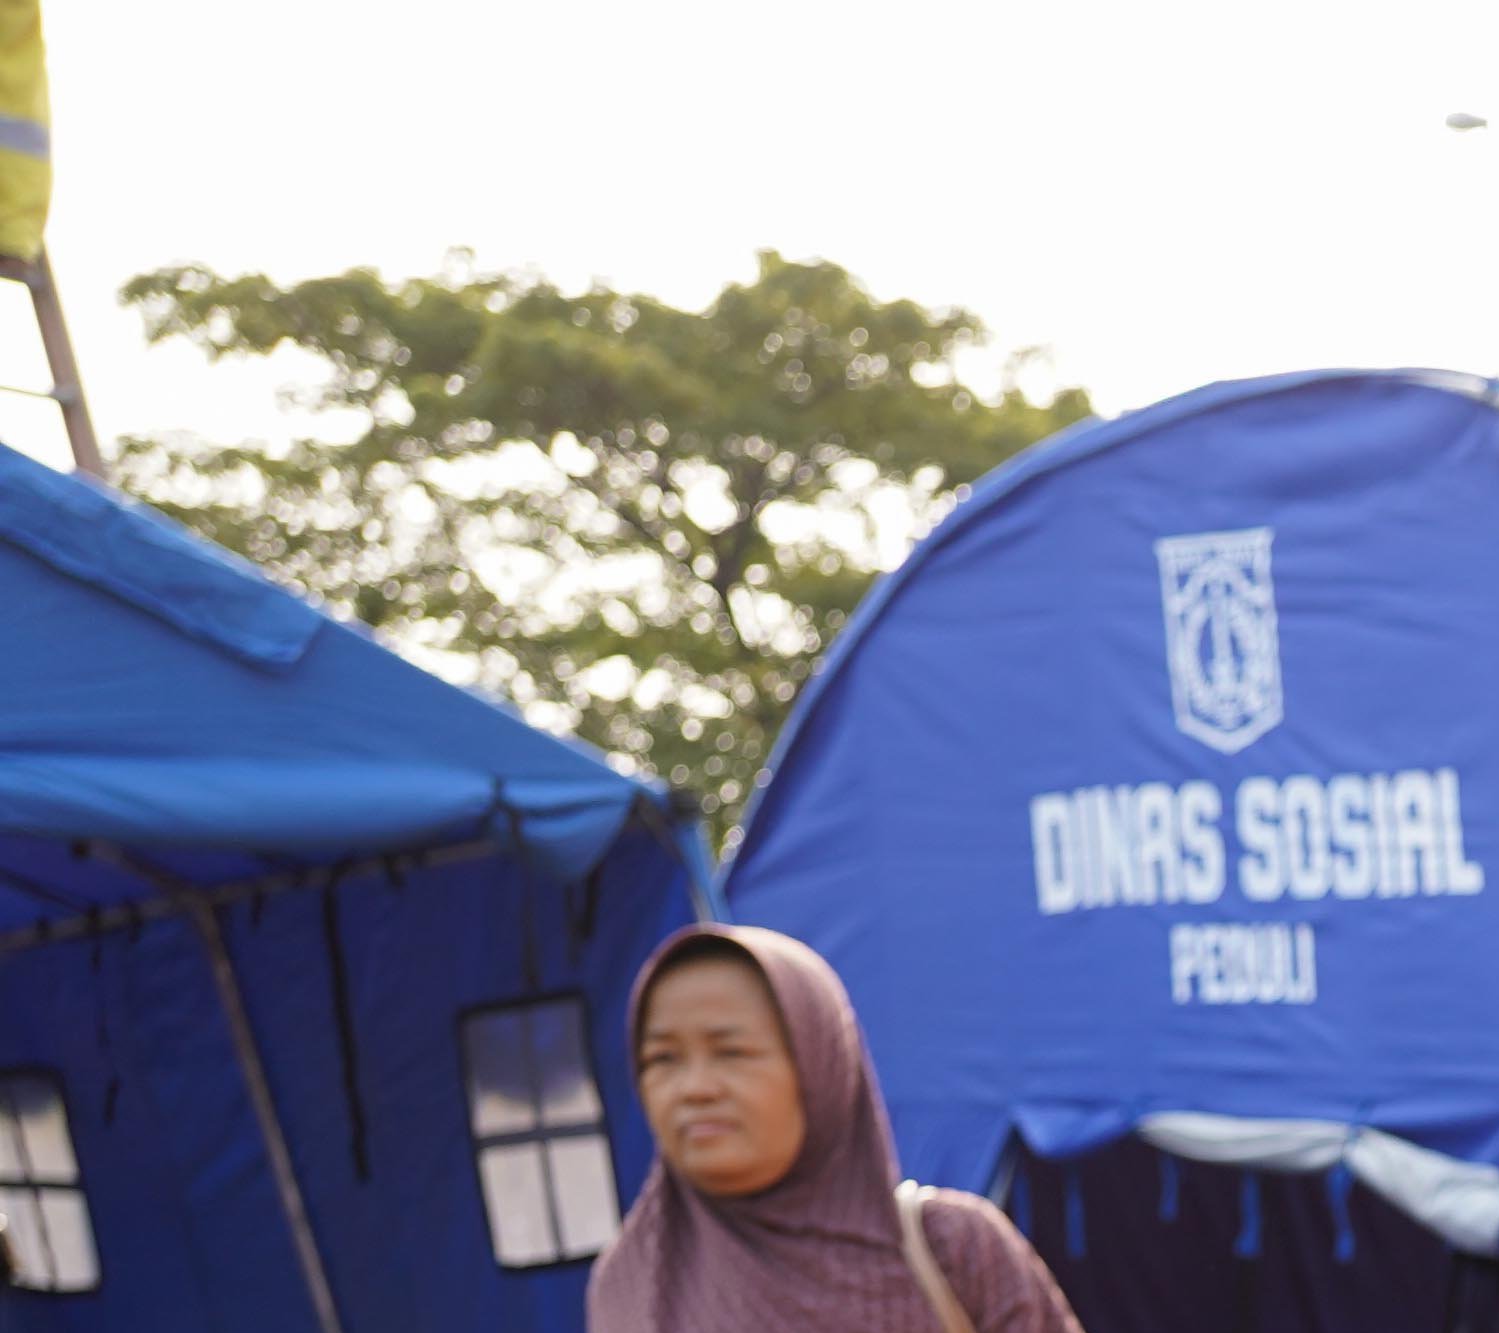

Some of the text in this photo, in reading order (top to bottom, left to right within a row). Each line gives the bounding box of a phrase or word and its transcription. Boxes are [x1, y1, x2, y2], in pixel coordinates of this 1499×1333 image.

[1031, 768, 1484, 914] DINAS SOSIAL
[1171, 923, 1318, 1004] PEDULI
